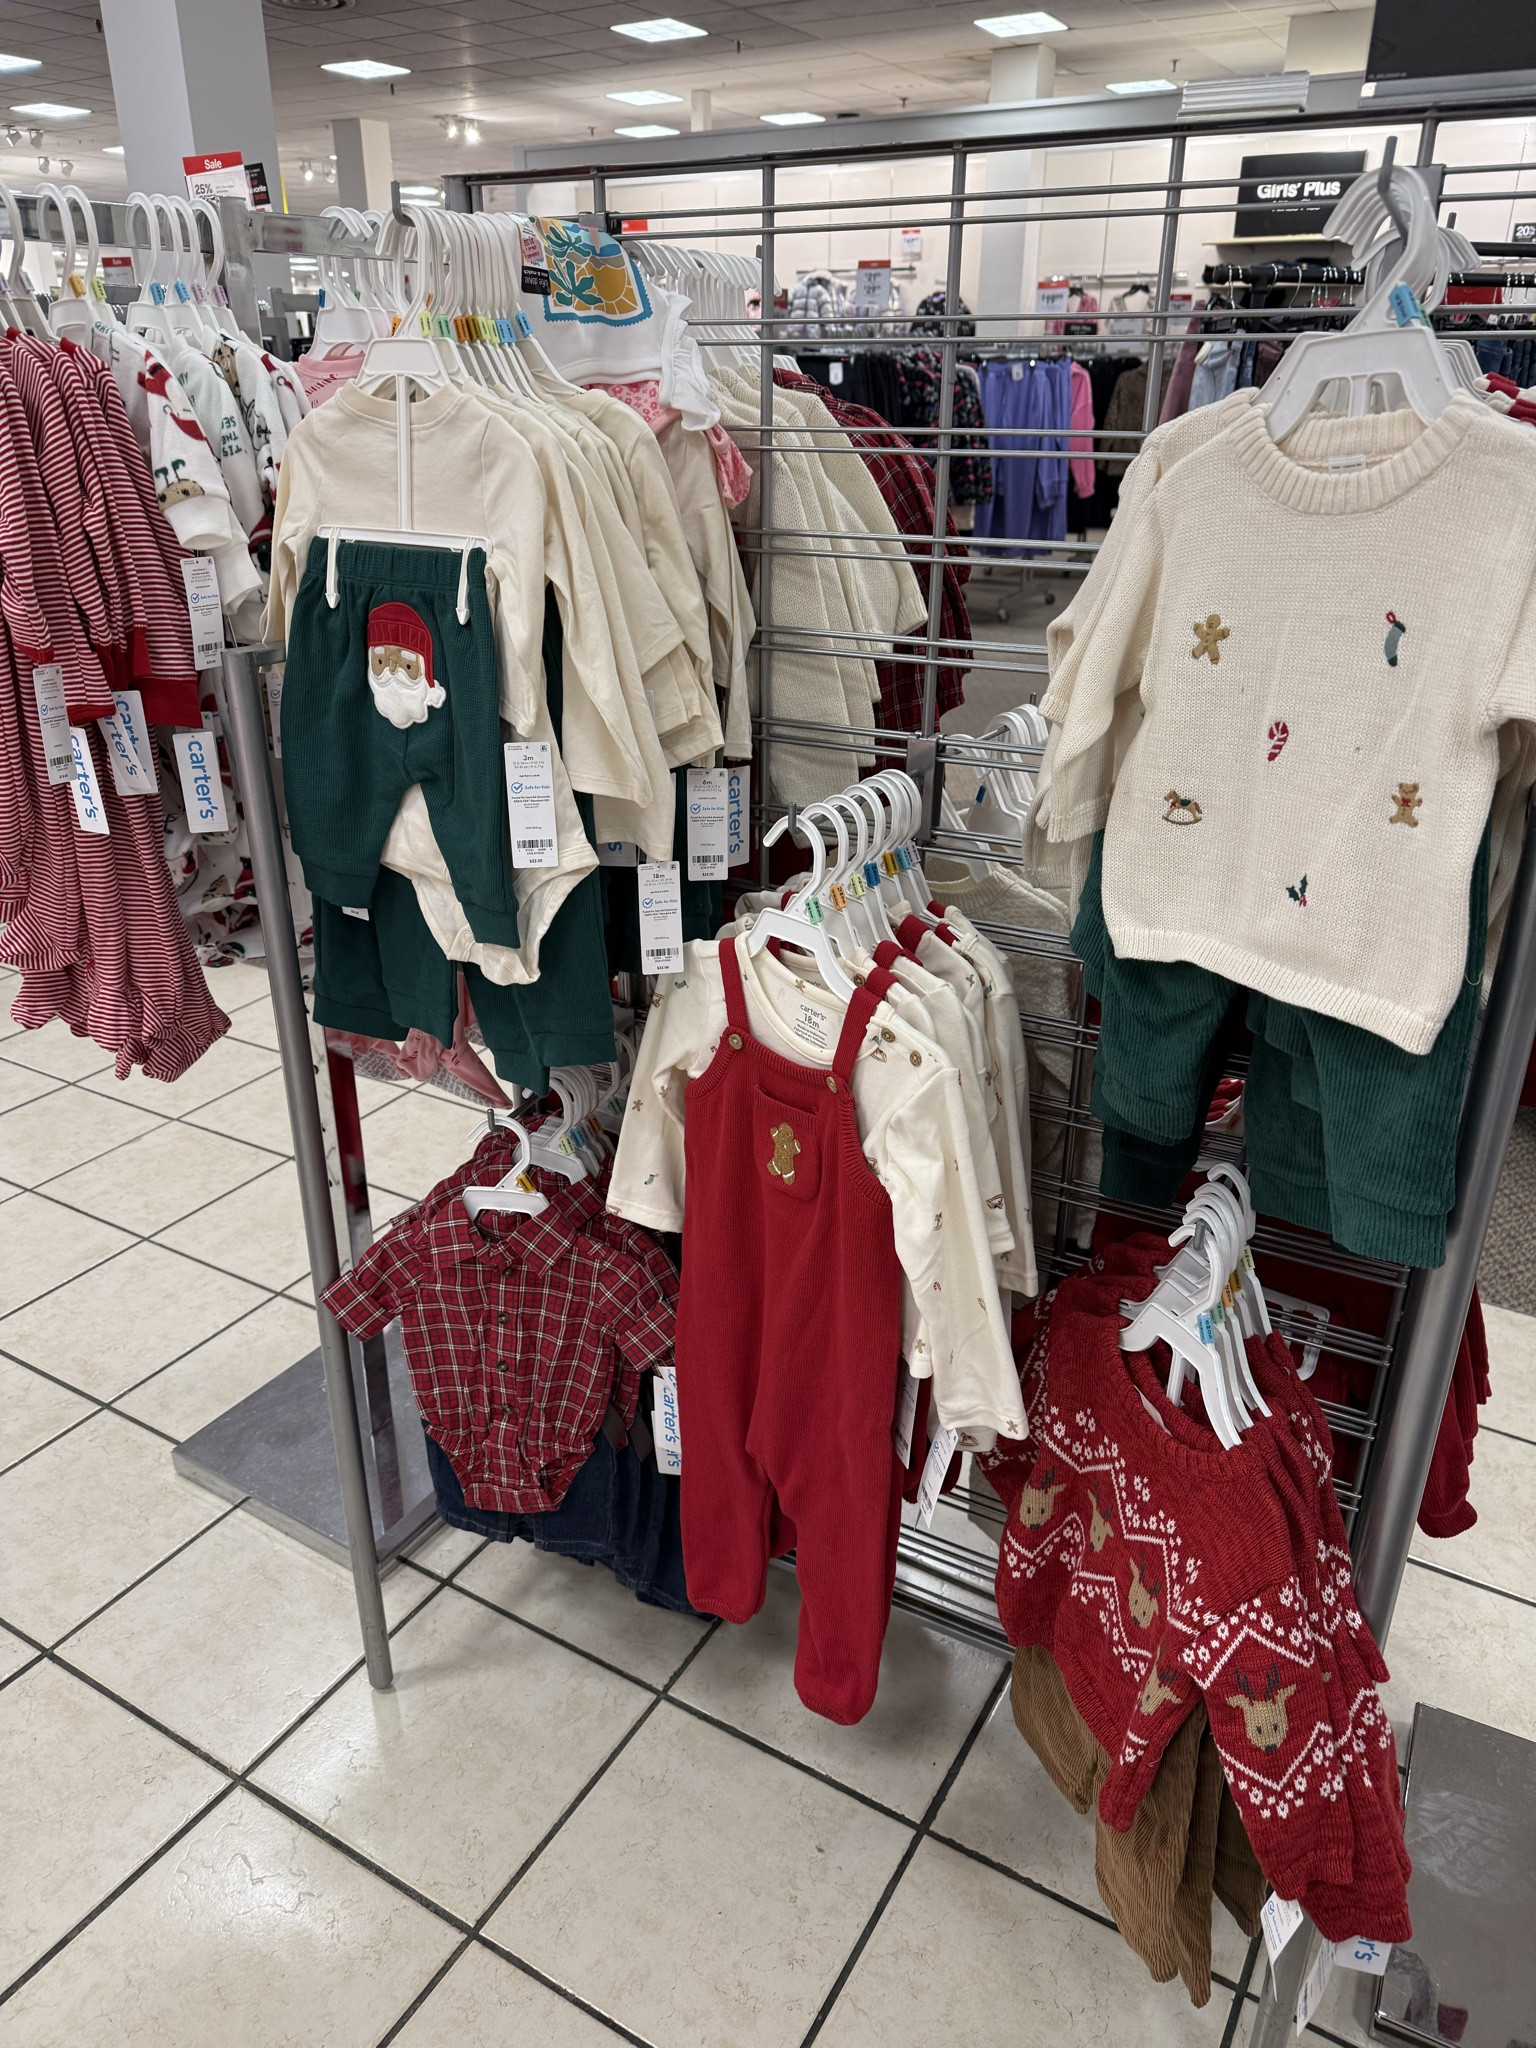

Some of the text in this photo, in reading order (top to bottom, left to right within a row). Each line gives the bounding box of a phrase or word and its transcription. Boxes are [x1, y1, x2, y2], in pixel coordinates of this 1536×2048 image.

[204, 159, 222, 170] Sale
[195, 183, 213, 195] 25%
[1257, 181, 1340, 199] Girls' Plus
[221, 431, 238, 444] THE
[104, 714, 137, 776] arter's
[188, 740, 218, 819] carter's
[729, 775, 744, 854] carter's
[800, 1004, 825, 1021] carter's
[804, 1013, 820, 1029] 18m
